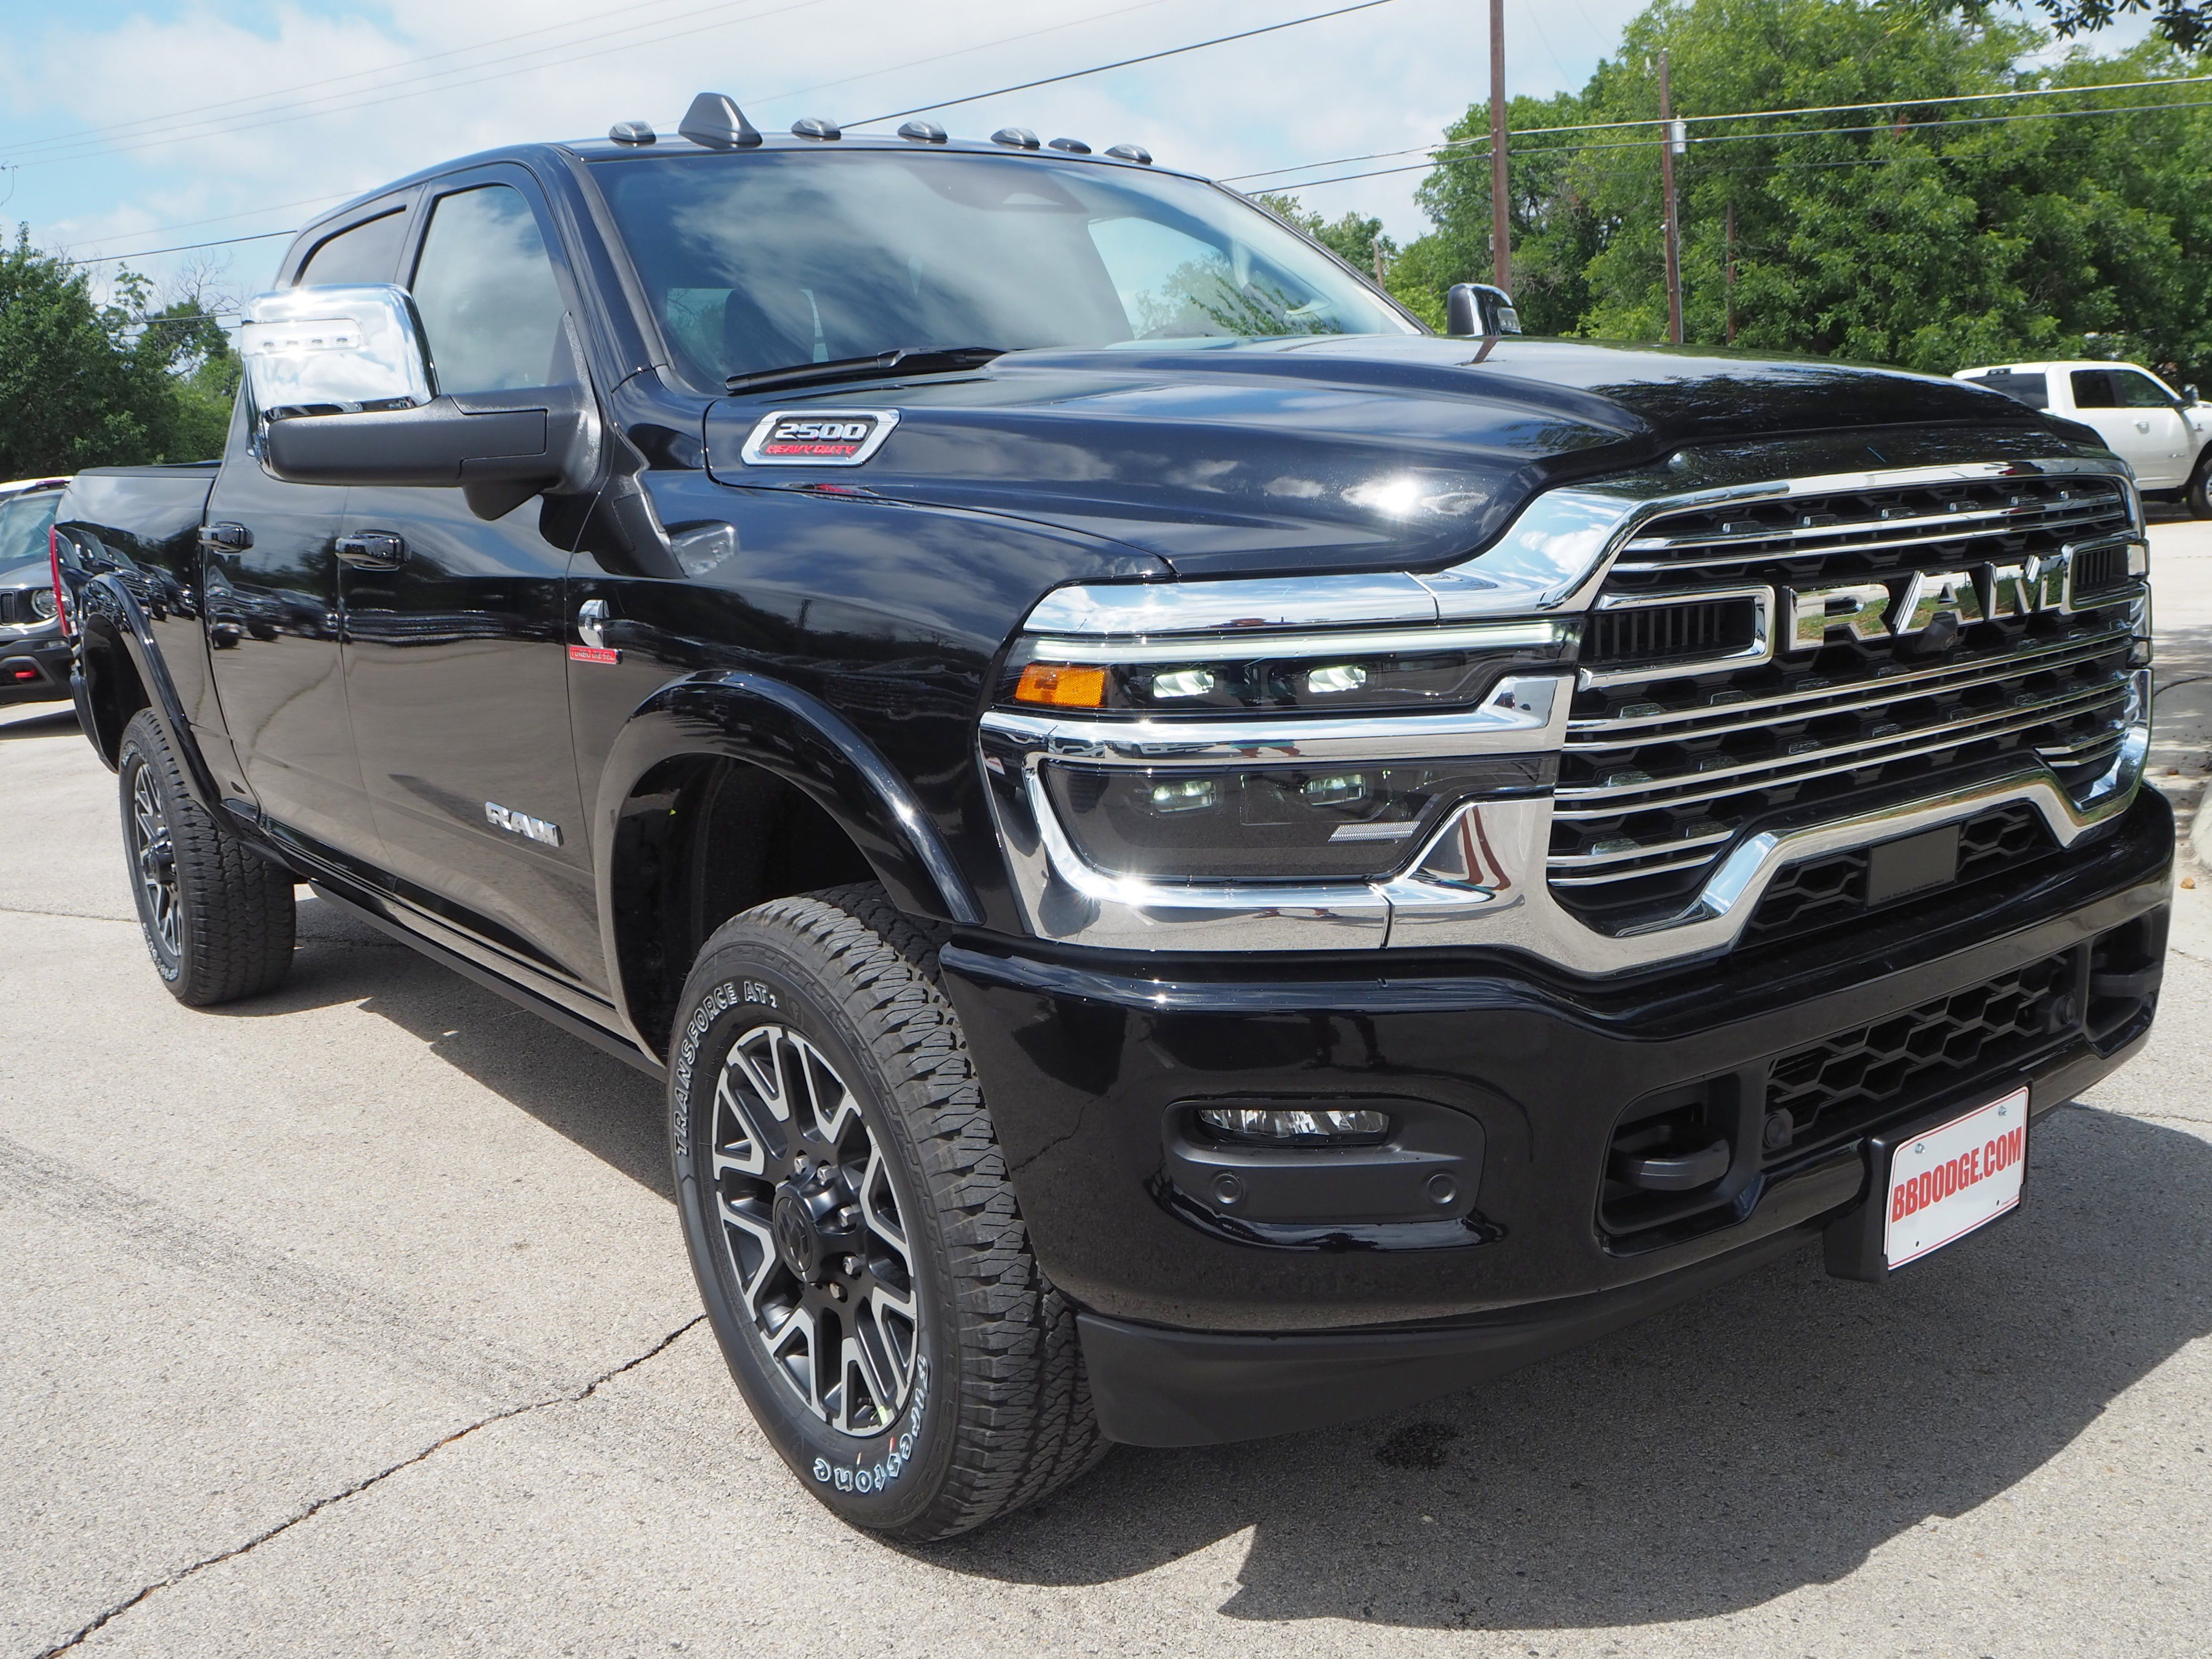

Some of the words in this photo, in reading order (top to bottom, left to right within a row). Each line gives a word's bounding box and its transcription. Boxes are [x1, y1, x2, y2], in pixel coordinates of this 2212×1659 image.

[766, 444, 813, 455] HEAVY
[813, 445, 857, 455] DUTY
[774, 423, 869, 442] 2500
[1783, 554, 2068, 652] RAM
[485, 801, 564, 848] RAM
[675, 982, 738, 1156] TRANSFORCE
[1892, 1126, 2023, 1223] BBDODGE.COM
